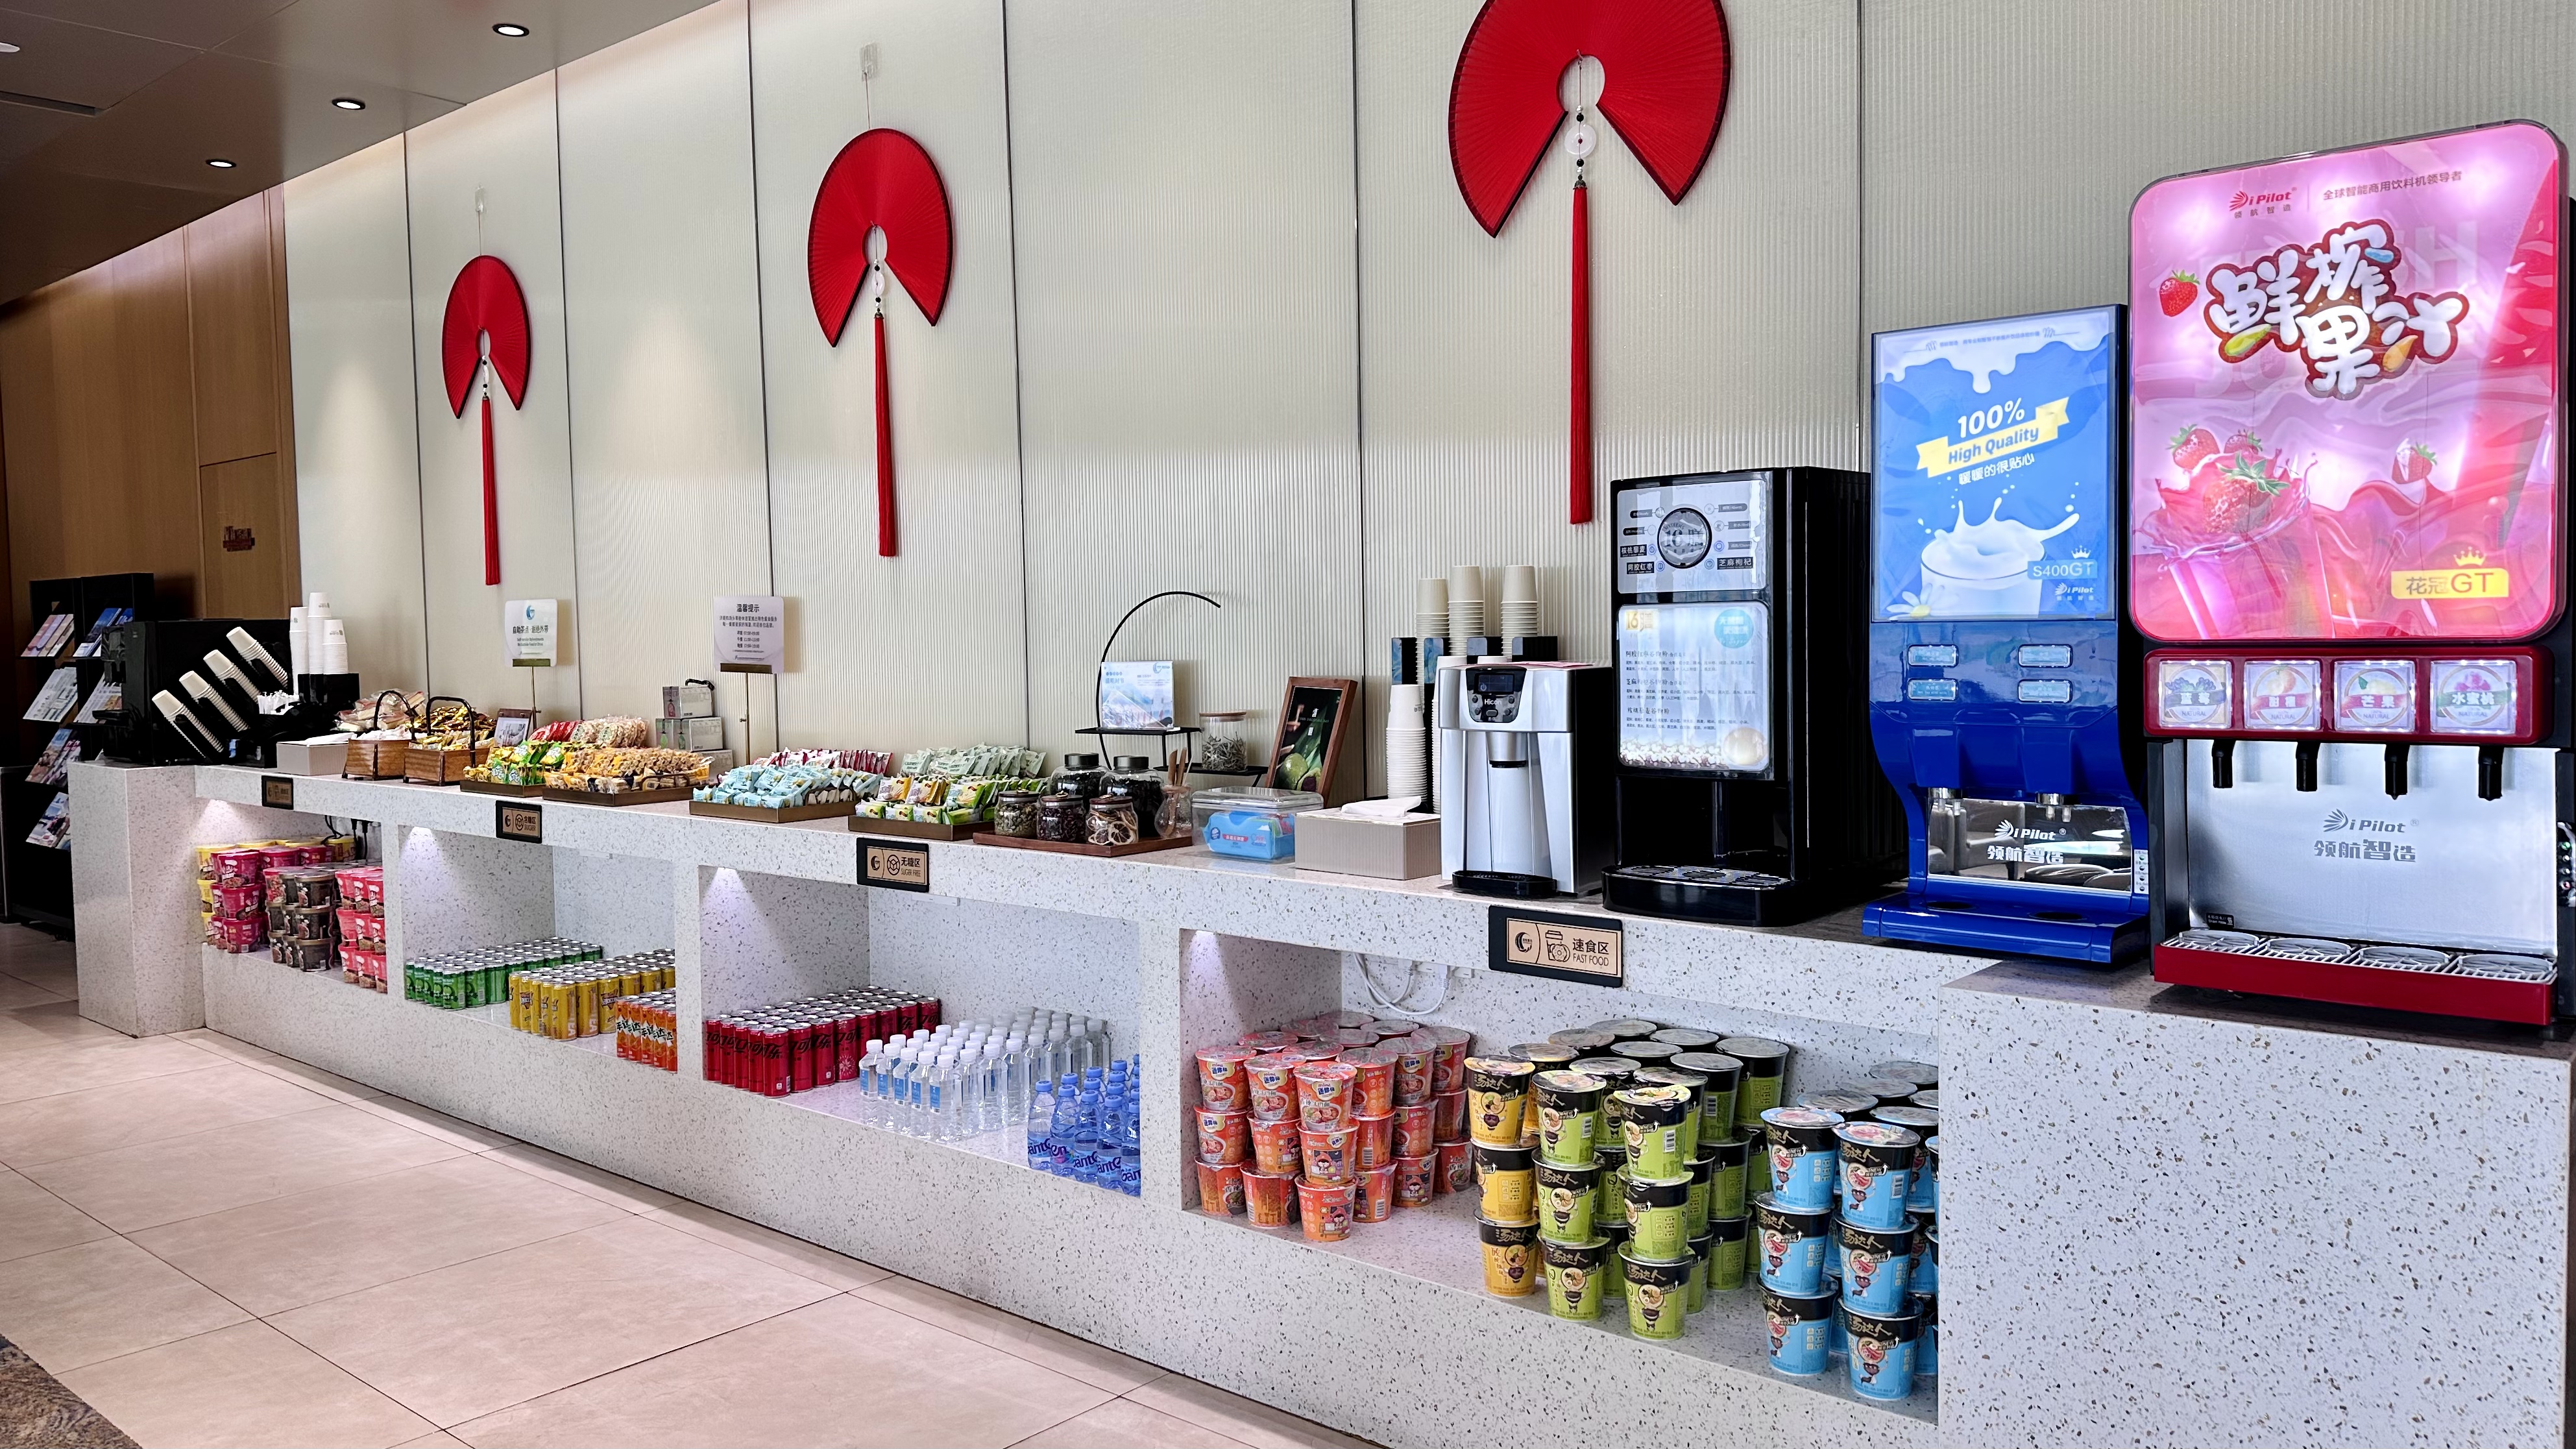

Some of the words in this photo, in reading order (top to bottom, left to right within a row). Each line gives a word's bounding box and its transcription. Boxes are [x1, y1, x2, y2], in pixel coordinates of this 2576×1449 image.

[2323, 171, 2462, 201] 全球智能商用饮料机领导者
[2256, 192, 2292, 204] Pilot
[1958, 397, 2025, 438] 100%
[1948, 444, 1982, 465] High
[1985, 427, 2039, 454] Quality
[1959, 453, 2035, 485] 暖暖的很贴心
[2033, 561, 2095, 577] S400GT
[2406, 572, 2494, 596] 花冠GT
[736, 603, 760, 613] 温馨提示
[2361, 695, 2396, 708] 芒果
[2451, 691, 2495, 705] 水蜜桃
[2020, 827, 2056, 841] Pilot
[2358, 819, 2407, 834] Pilot
[1987, 844, 2065, 864] 领航智造
[2313, 838, 2417, 862] 领航智造
[901, 857, 921, 868] 无糖区
[1572, 938, 1609, 955] 速食区
[1573, 953, 1586, 964] FAST
[1589, 956, 1609, 966] FOOD
[1474, 1073, 1511, 1090] 汤达人
[1840, 1141, 1881, 1163] 汤达人
[1540, 1168, 1579, 1186] 汤达人
[1756, 1207, 1795, 1230] 汤达人
[1496, 1228, 1532, 1242] 汤达人
[1842, 1227, 1884, 1250] 汤达人
[1549, 1249, 1588, 1265] 汤达人
[1627, 1263, 1667, 1282] 汤达人
[1849, 1312, 1892, 1337] 汤达人
